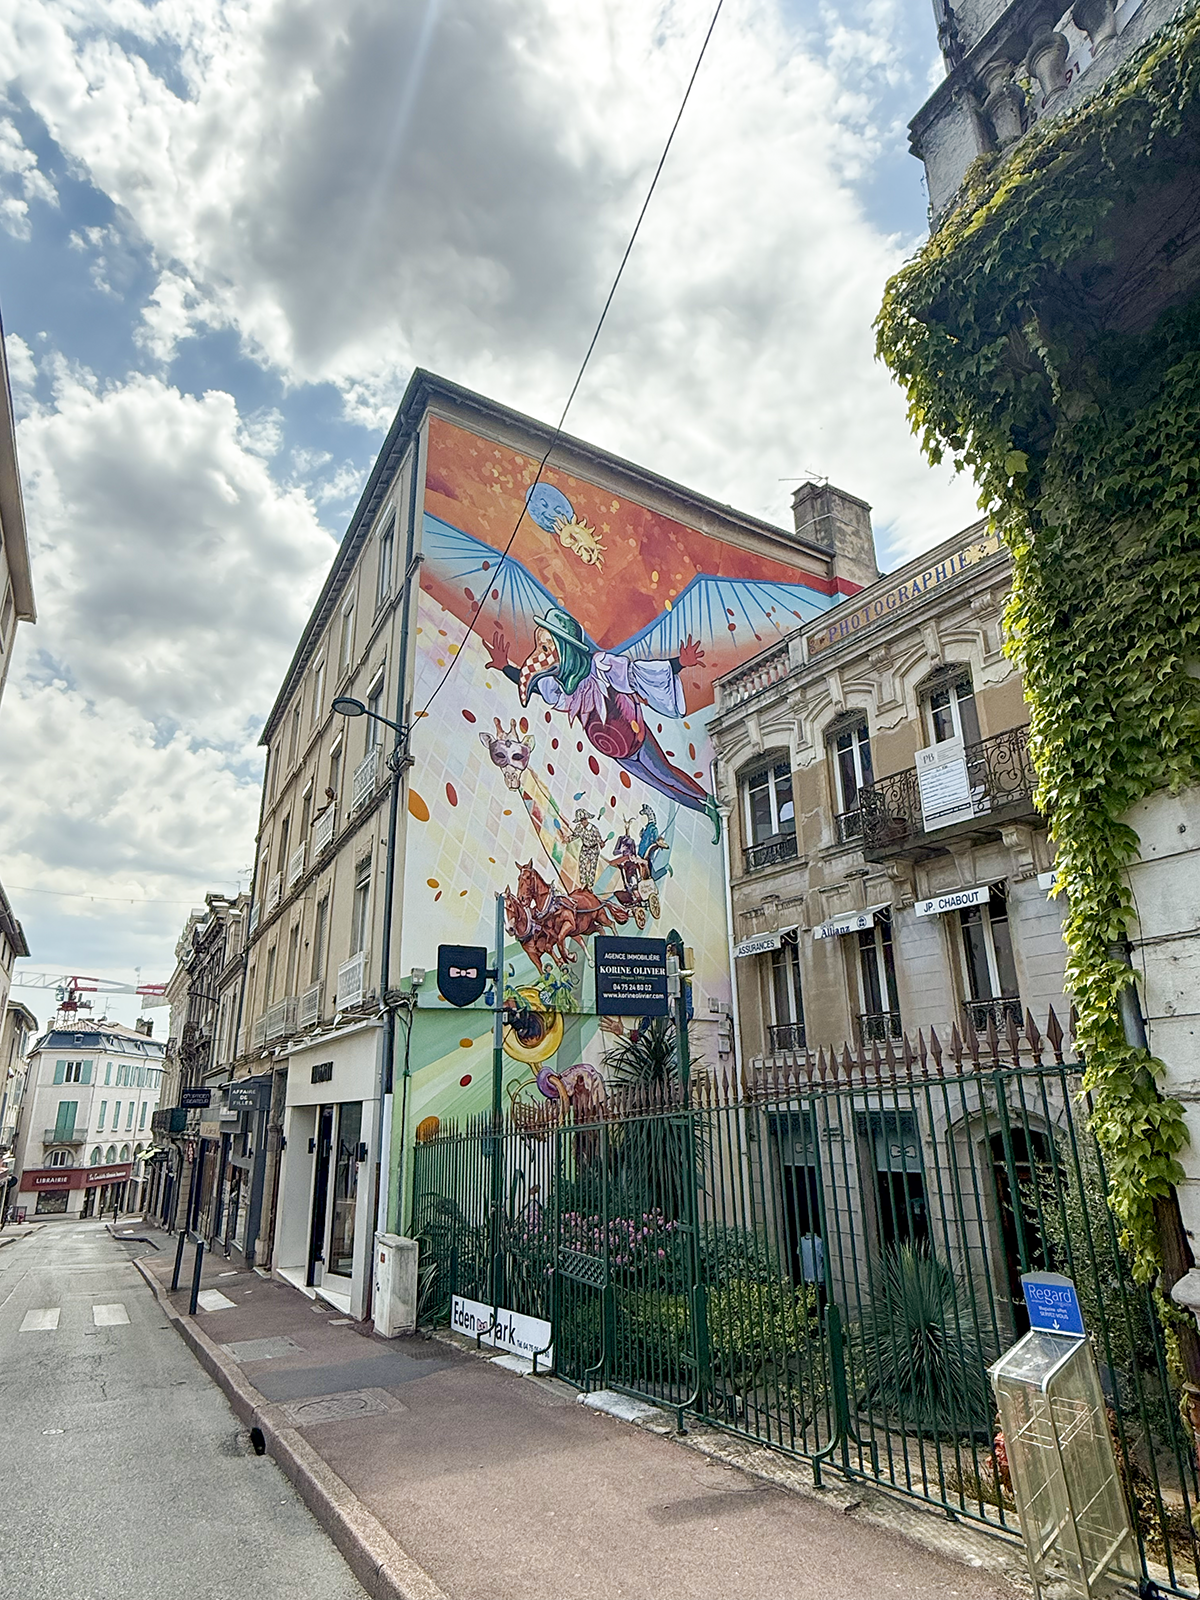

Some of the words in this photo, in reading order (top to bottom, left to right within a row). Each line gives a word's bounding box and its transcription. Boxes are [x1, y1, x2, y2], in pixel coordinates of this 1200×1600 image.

[828, 549, 972, 643] PHOTOGRAPHIE
[938, 891, 979, 909] CHABOUT
[821, 924, 850, 939] Allianz
[738, 939, 775, 955] ASSURANCES
[604, 952, 626, 960] AGENCE
[626, 953, 660, 961] IMMOBILIÈRE
[600, 965, 632, 975] KORINE
[633, 966, 666, 975] OLIVIER
[613, 983, 621, 991] 04
[621, 983, 629, 991] 75
[629, 983, 636, 991] 24
[1028, 1285, 1071, 1305] Regard
[454, 1301, 475, 1331] Eden
[489, 1313, 516, 1345] Park
